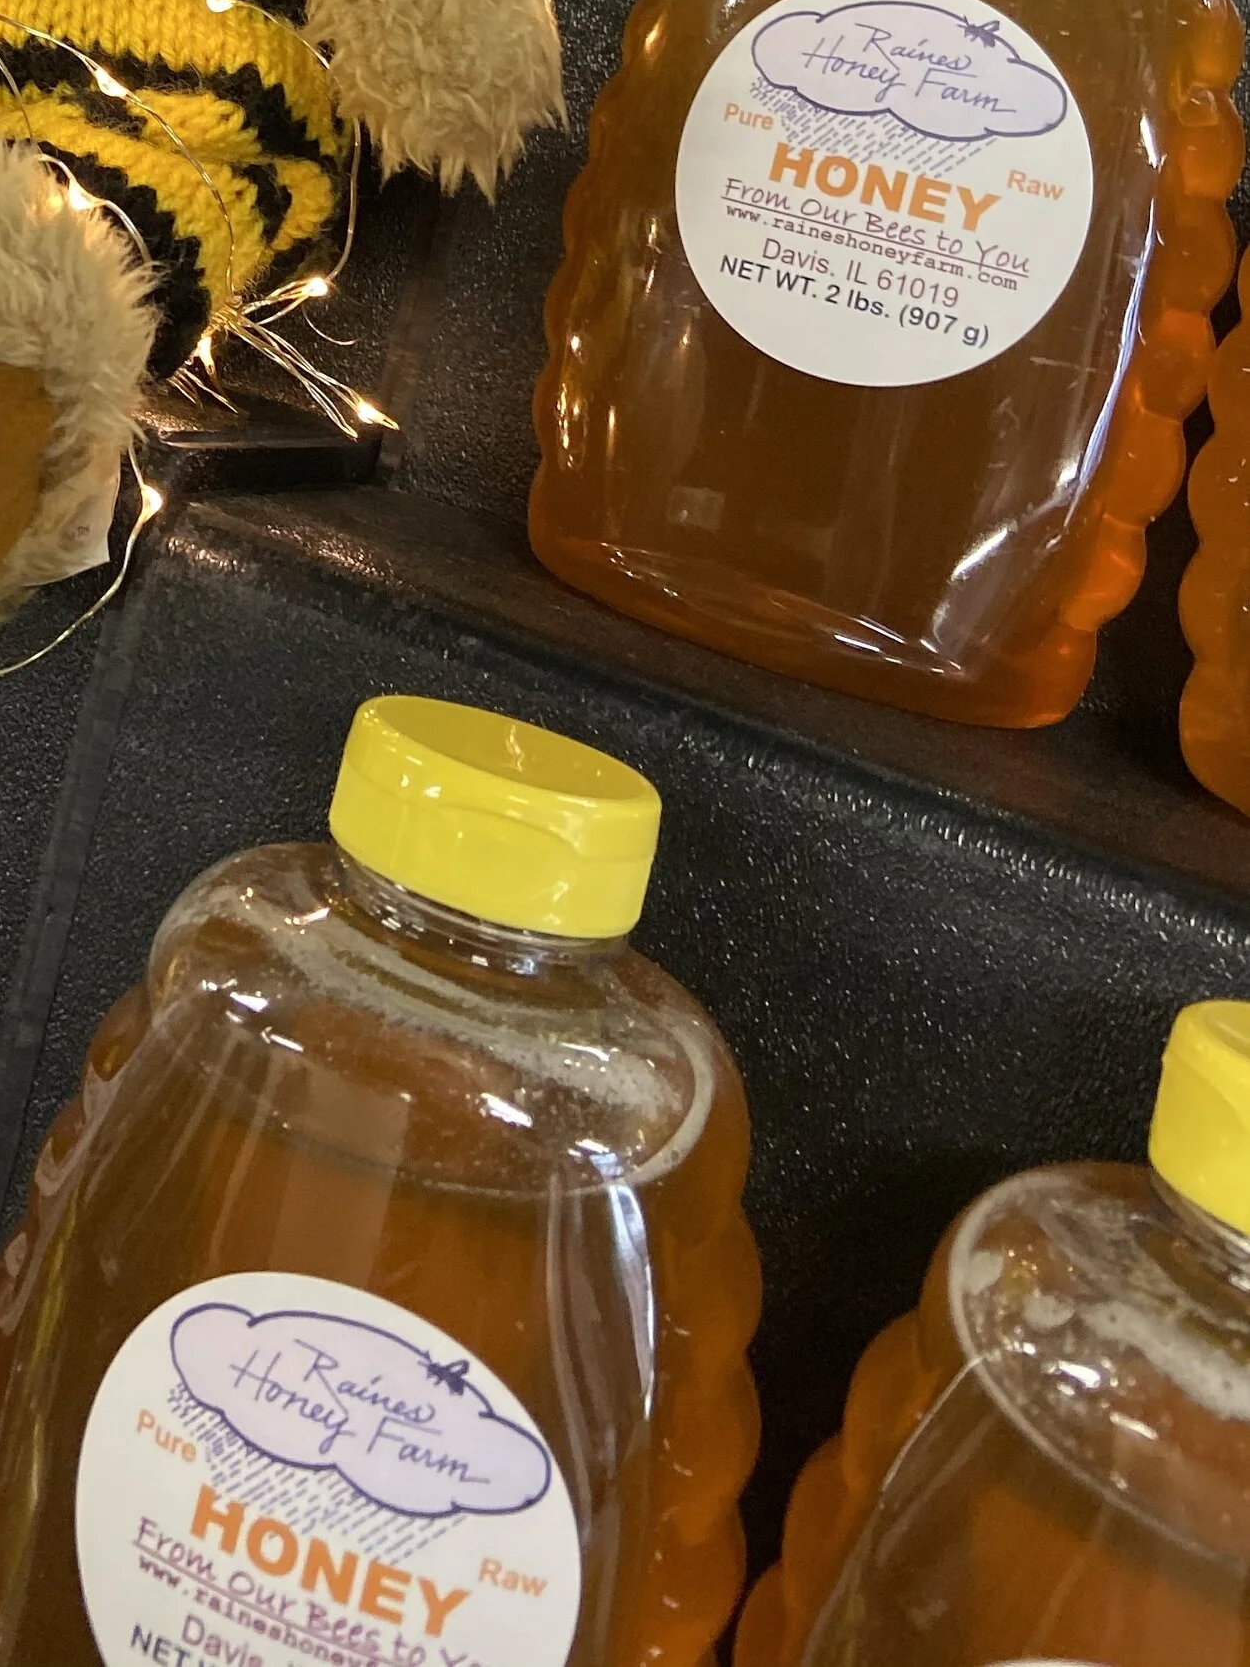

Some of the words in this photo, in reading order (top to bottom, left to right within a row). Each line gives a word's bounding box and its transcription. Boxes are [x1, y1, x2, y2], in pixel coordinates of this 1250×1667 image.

[802, 35, 906, 103] Honey
[915, 68, 1017, 114] Farm
[855, 22, 978, 78] Raines
[723, 102, 775, 132] Pure
[724, 177, 791, 212] From
[800, 197, 855, 227] Our
[865, 211, 926, 246] Bees
[936, 233, 964, 255] to
[975, 239, 1031, 274] You
[768, 141, 1002, 233] HONEY
[1006, 168, 1065, 202] Raw
[726, 203, 1018, 292] www.raineshoneyfarm.com
[846, 259, 868, 286] IL
[877, 270, 960, 309] 61019
[719, 254, 771, 284] NET
[776, 268, 818, 299] WT.
[825, 284, 841, 305] 2
[848, 290, 891, 320] lbs.
[898, 301, 958, 336] (907
[962, 324, 991, 350] g)
[230, 1348, 356, 1454] Honey
[366, 1415, 490, 1485] Farm
[293, 1338, 442, 1436] Raines
[135, 1409, 197, 1463] Pure
[134, 1516, 218, 1581] From
[227, 1569, 298, 1622] Our
[307, 1600, 382, 1655] Bees
[190, 1483, 471, 1639] HONEY
[478, 1556, 549, 1598] Raw
